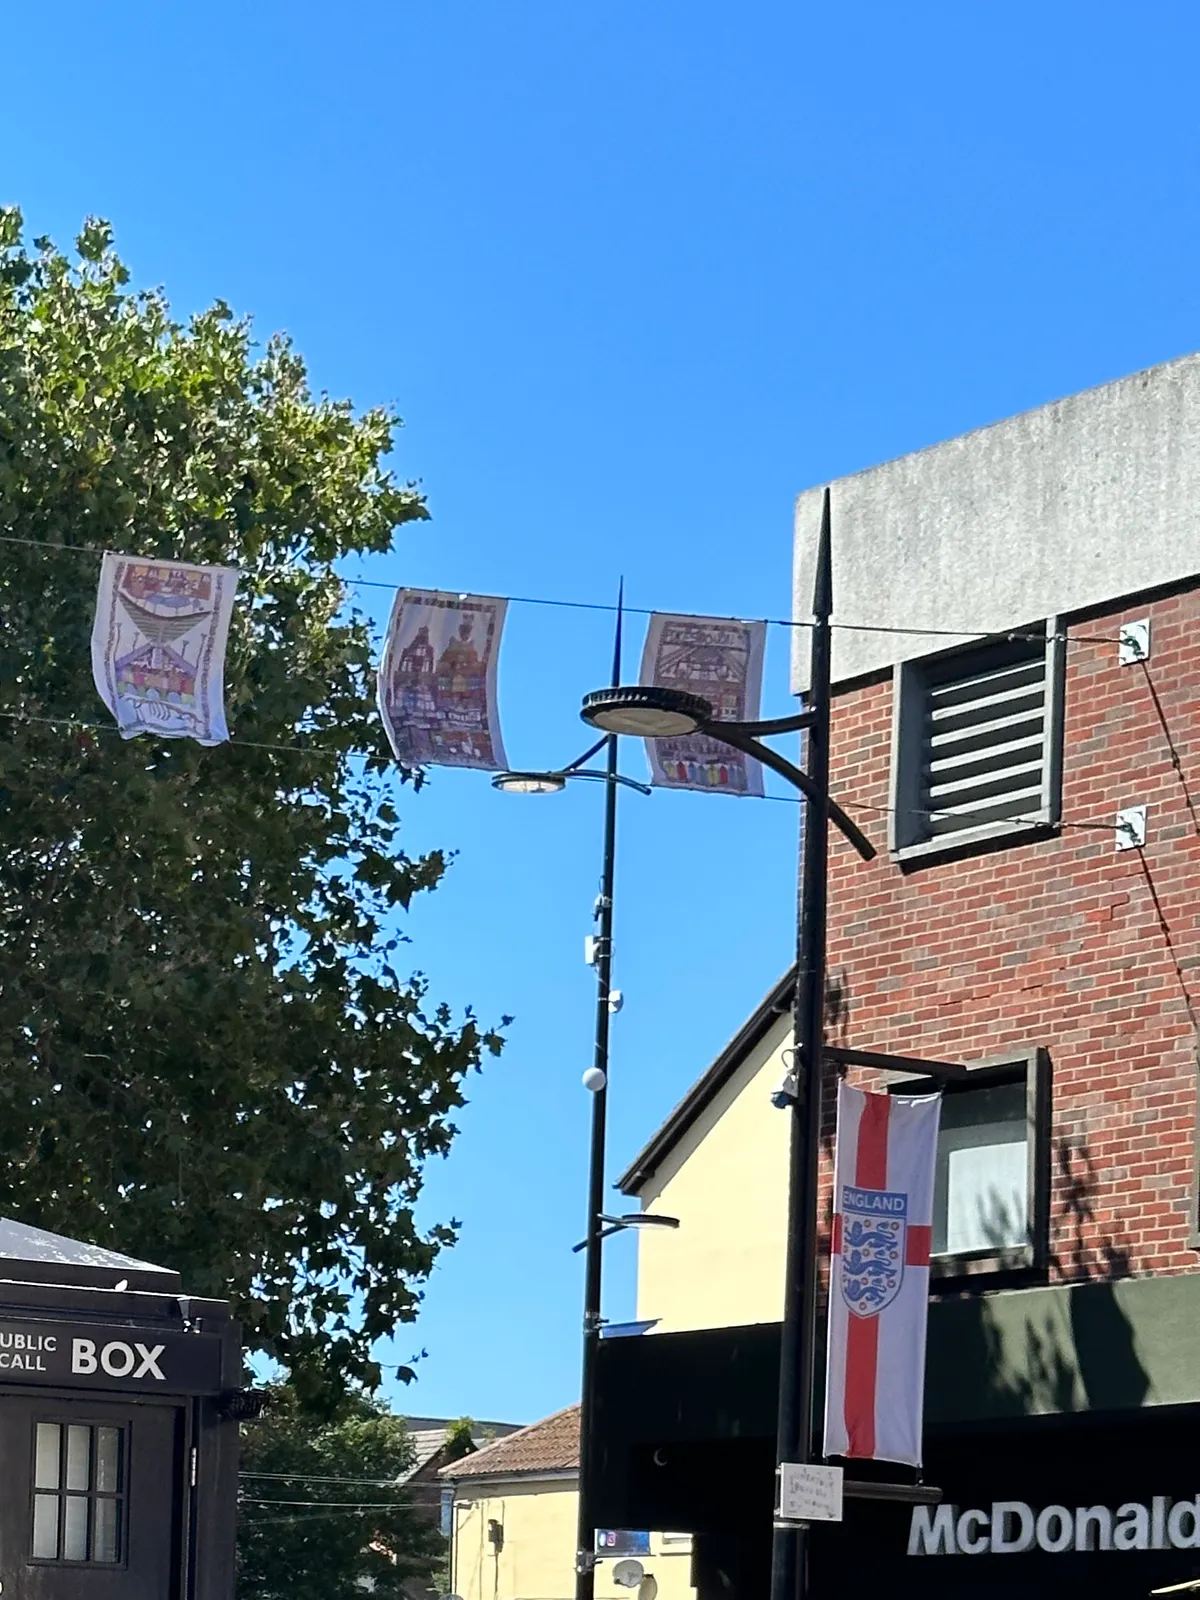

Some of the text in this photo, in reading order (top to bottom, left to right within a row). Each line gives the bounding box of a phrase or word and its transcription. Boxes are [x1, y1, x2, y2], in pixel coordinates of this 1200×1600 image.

[843, 1191, 905, 1211] ENGLAND
[72, 1338, 167, 1380] BOX
[907, 1494, 1200, 1556] McDonald
